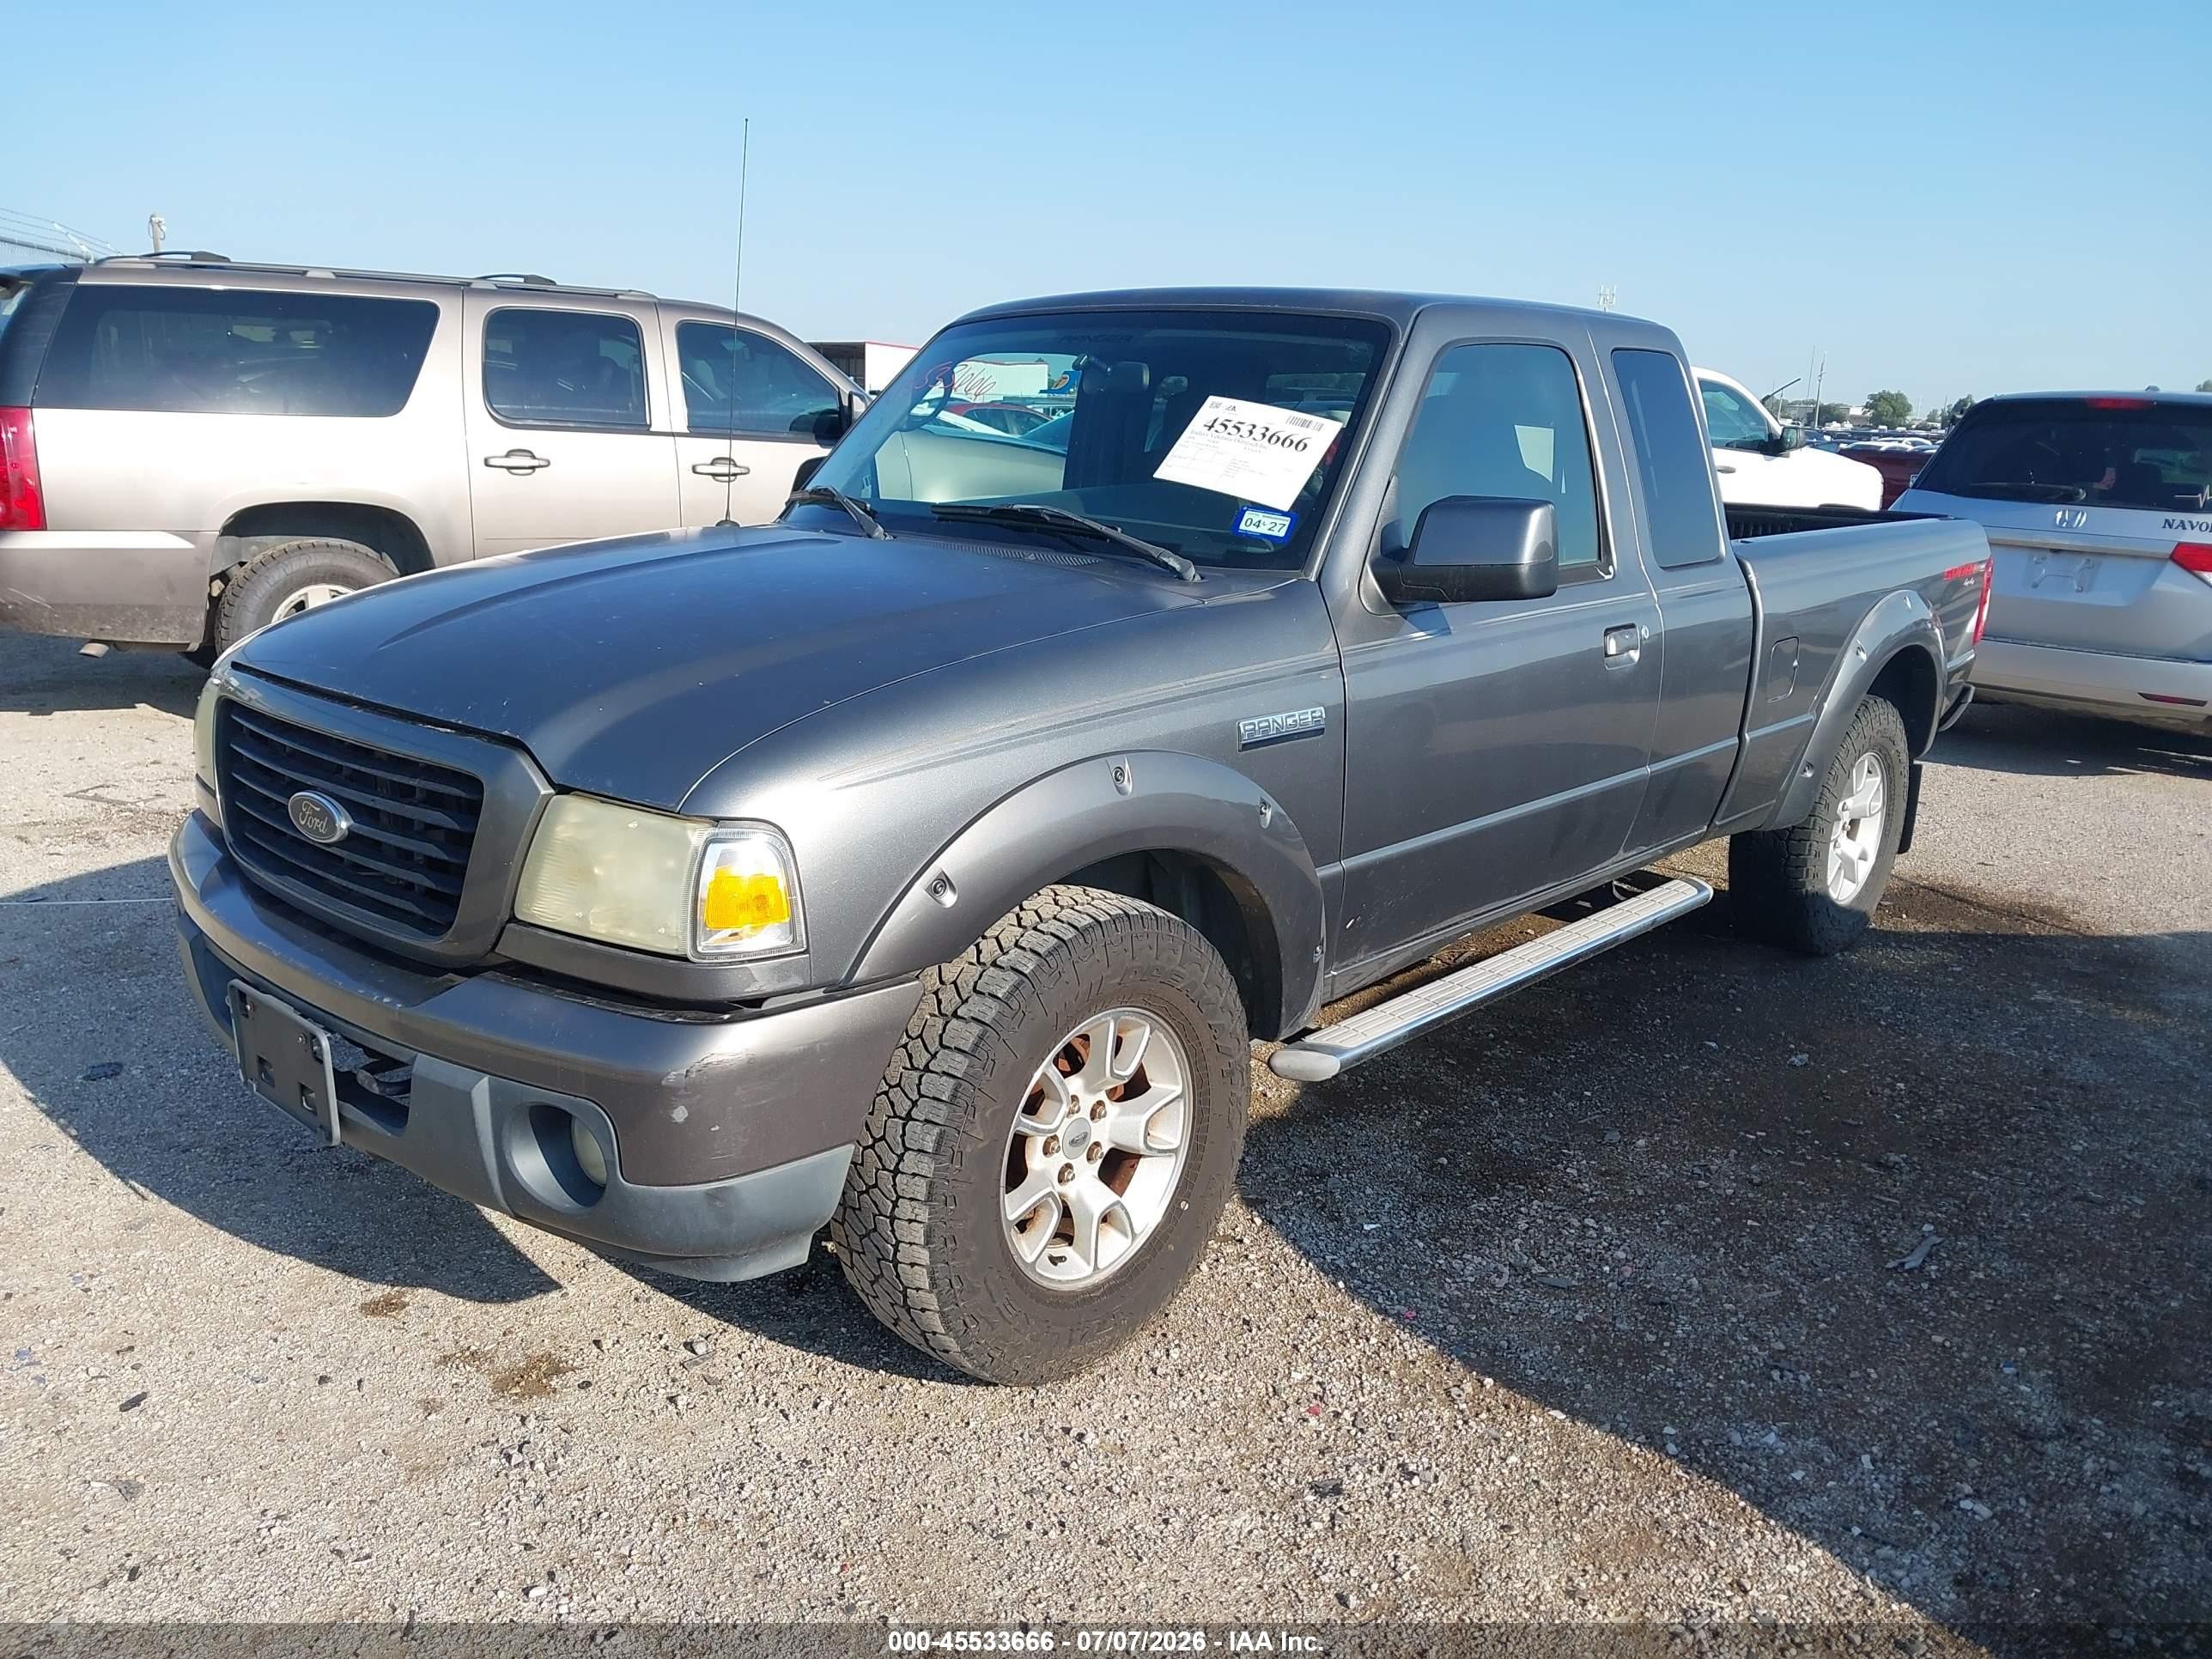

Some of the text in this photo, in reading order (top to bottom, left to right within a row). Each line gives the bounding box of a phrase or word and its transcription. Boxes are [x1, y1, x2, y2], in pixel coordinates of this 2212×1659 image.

[1203, 416, 1313, 453] 45533666
[1244, 517, 1261, 529] 04
[1267, 521, 1287, 533] 27
[2161, 518, 2212, 532] NAVO
[1241, 708, 1325, 741] RANGER
[299, 800, 328, 834] Ford
